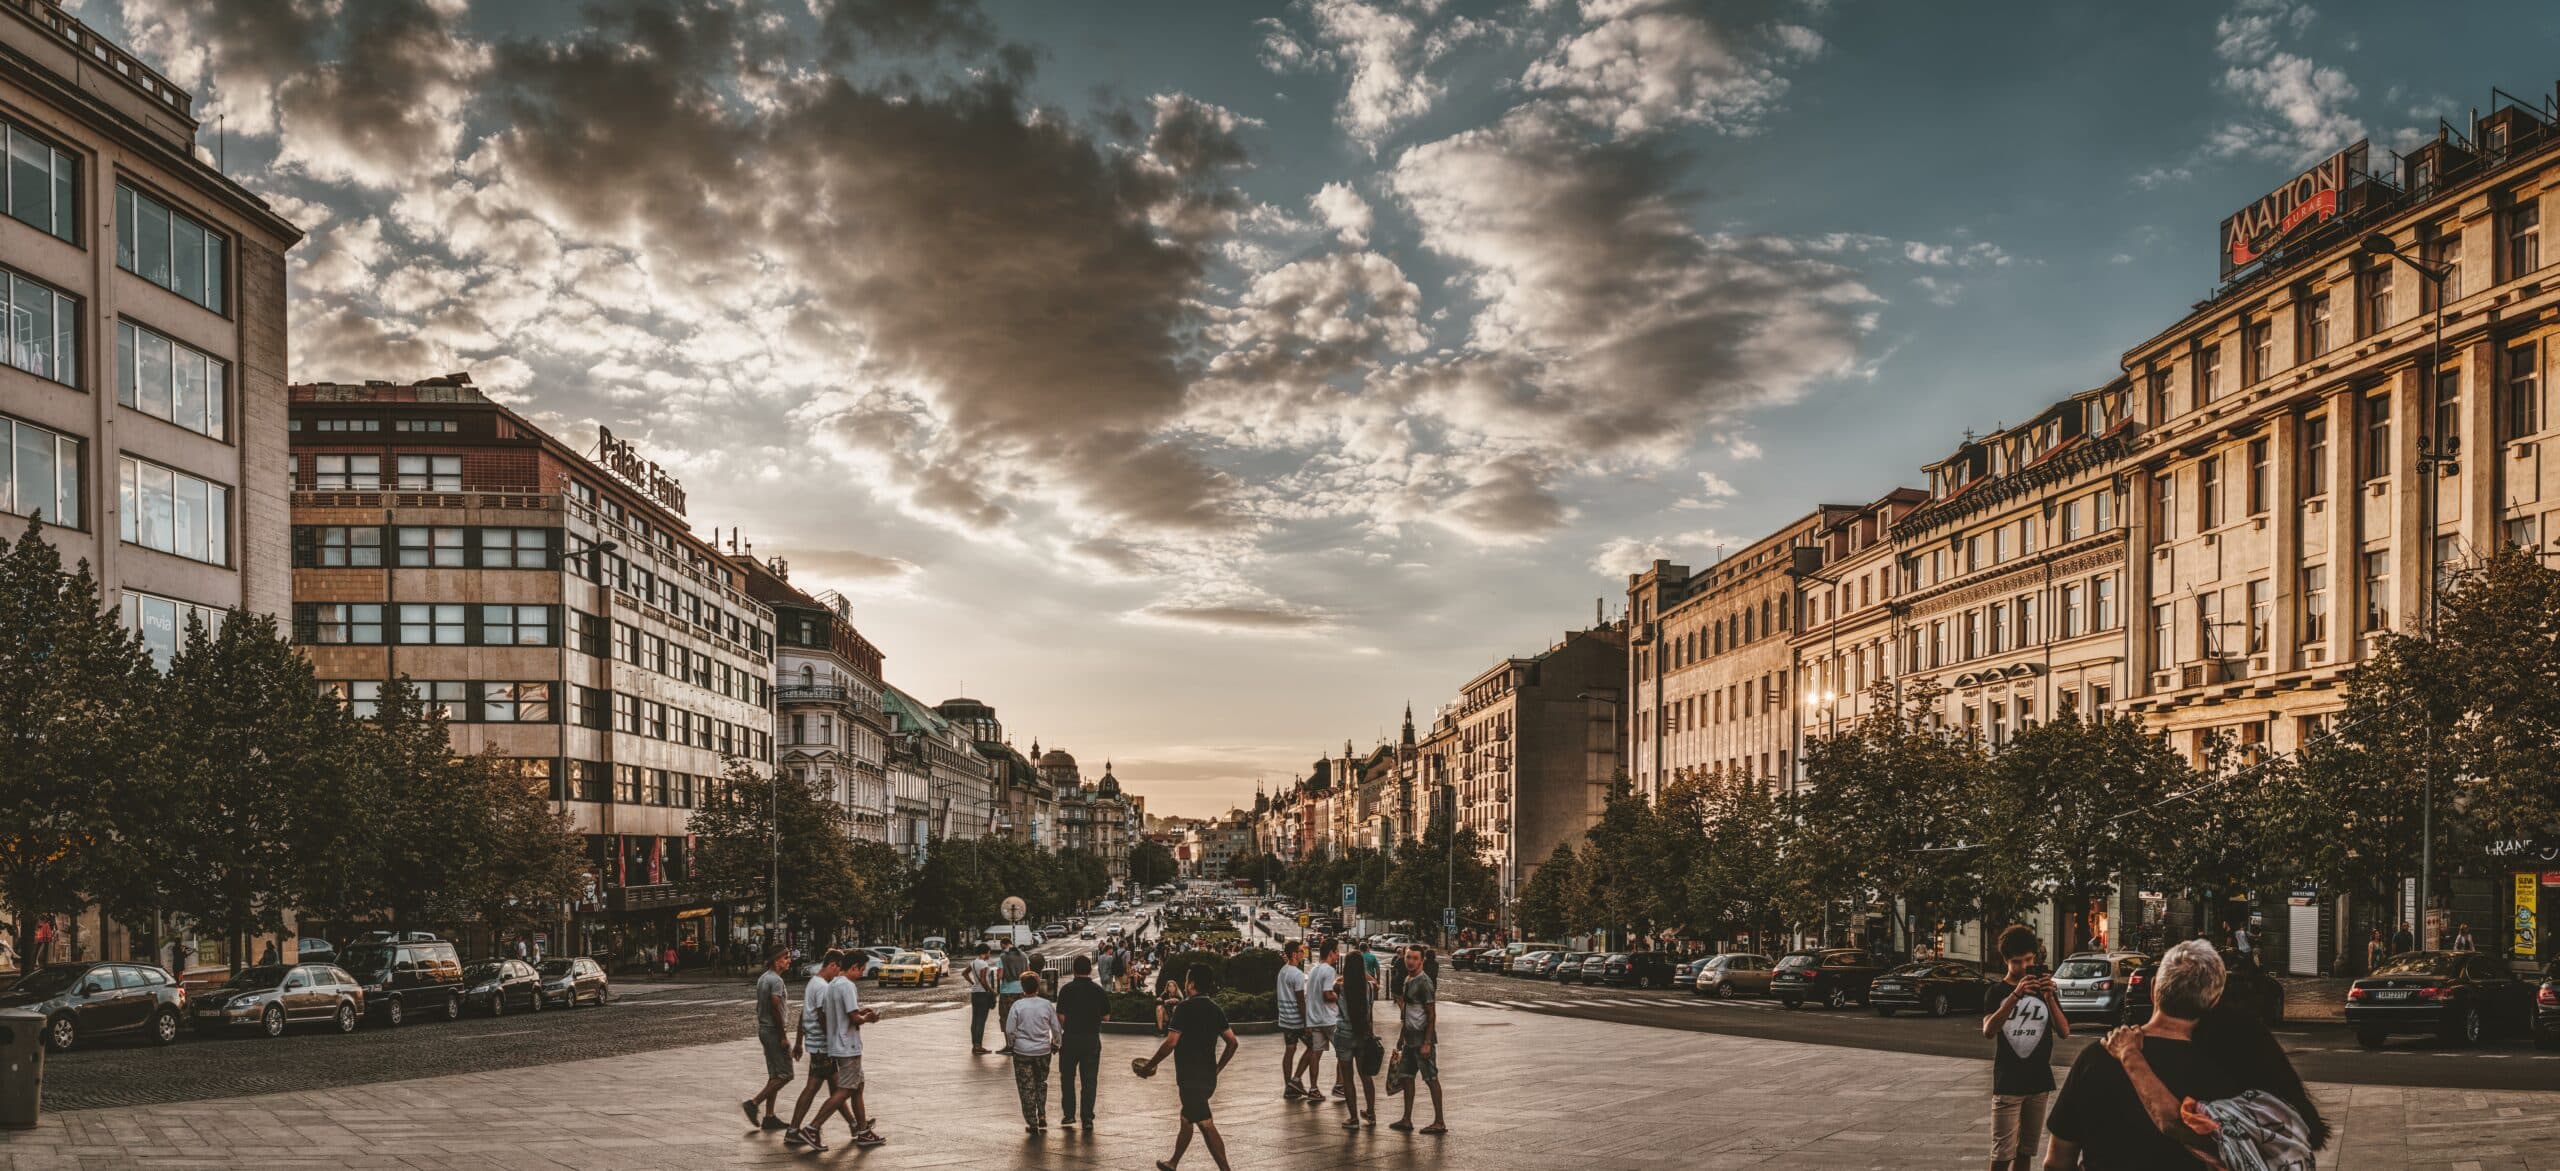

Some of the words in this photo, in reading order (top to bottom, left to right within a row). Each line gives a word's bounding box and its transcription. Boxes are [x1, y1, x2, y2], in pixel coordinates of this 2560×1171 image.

[2227, 152, 2345, 253] MATTONI
[599, 425, 646, 488] Palác
[649, 460, 687, 517] Fénix
[1345, 887, 1354, 900] P
